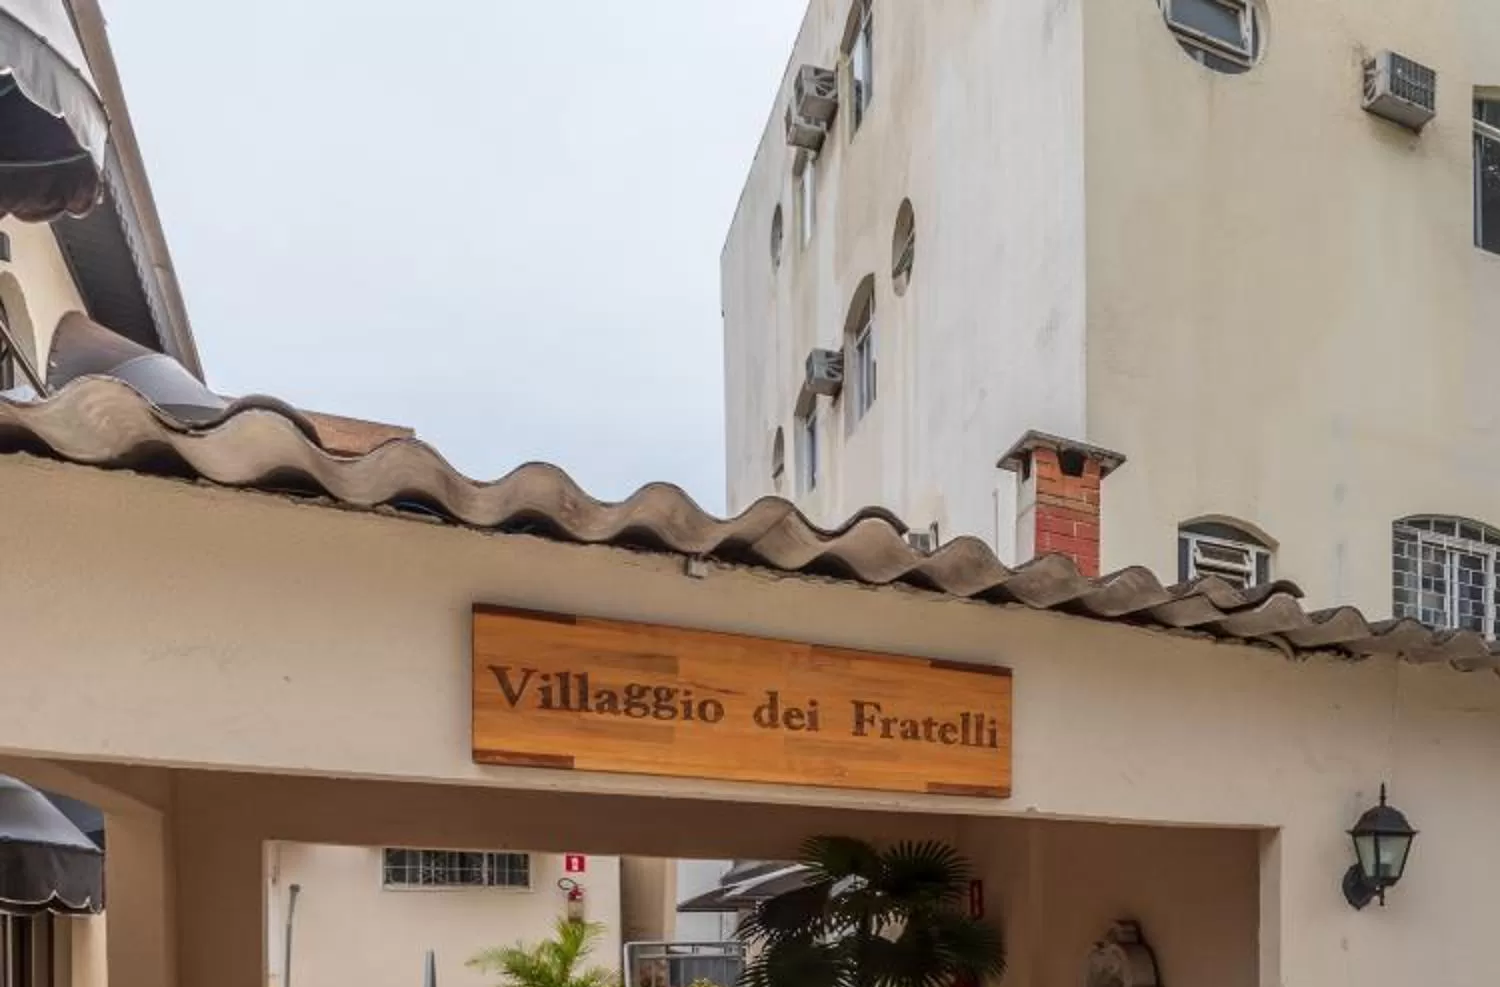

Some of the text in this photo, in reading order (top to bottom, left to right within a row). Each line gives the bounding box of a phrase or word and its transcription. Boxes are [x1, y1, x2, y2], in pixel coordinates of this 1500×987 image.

[488, 665, 998, 750] Villaggio dei Fratelli
